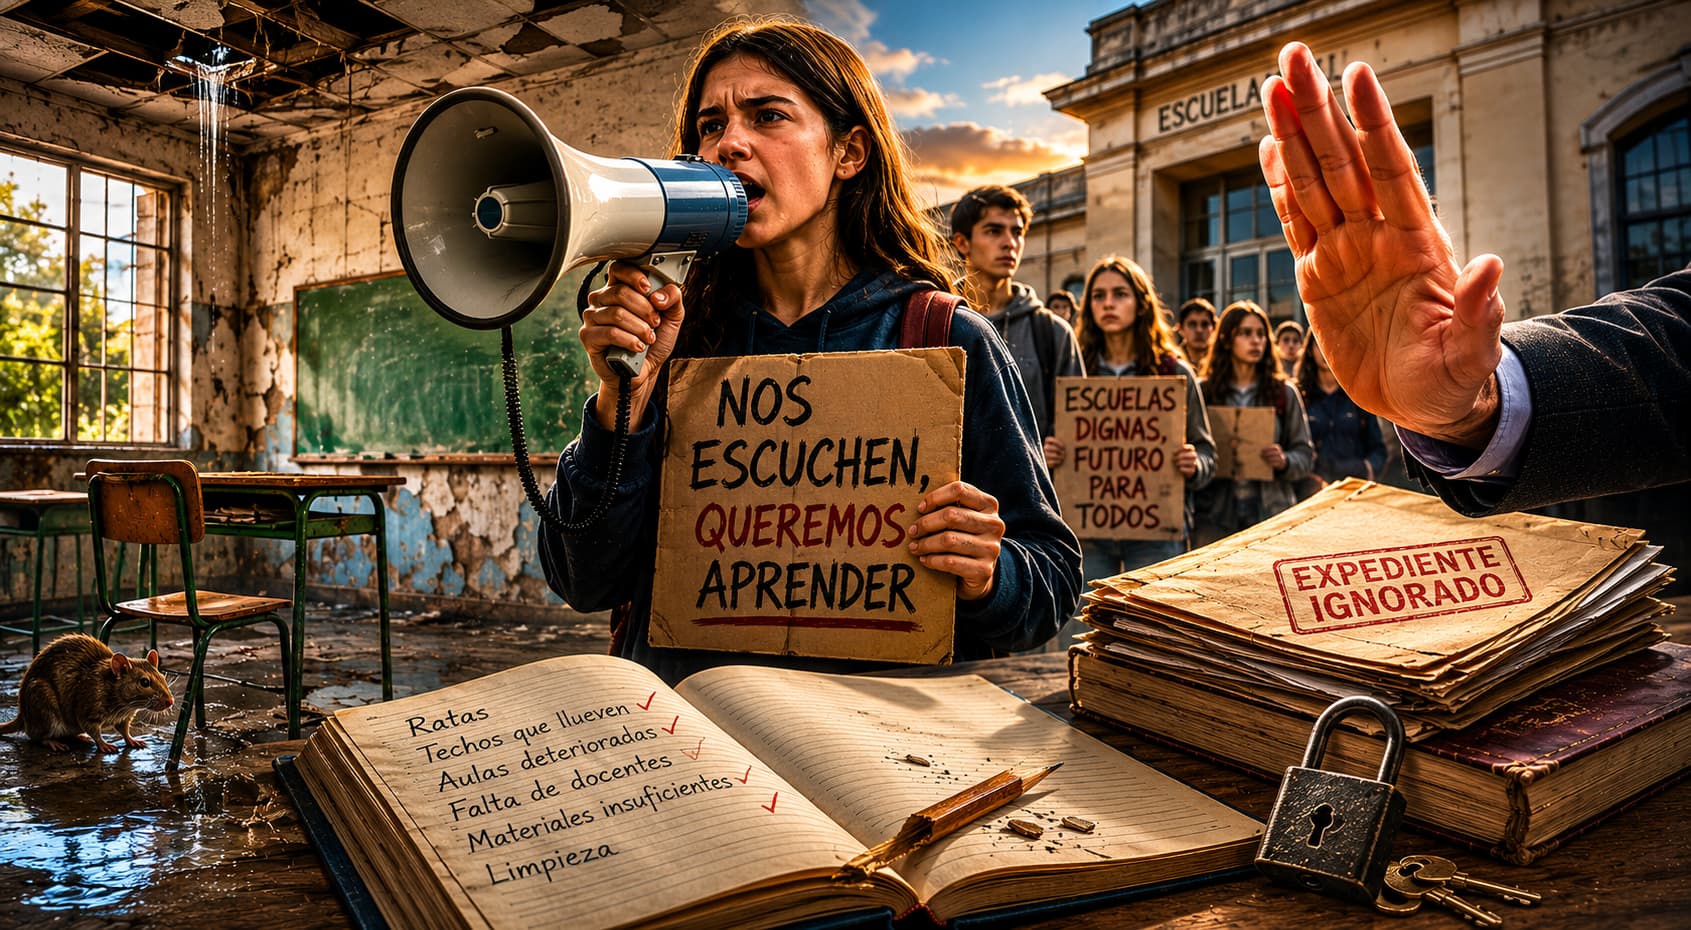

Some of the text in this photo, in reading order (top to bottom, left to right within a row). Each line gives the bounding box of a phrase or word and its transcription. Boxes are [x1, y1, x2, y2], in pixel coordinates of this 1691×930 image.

[1158, 77, 1262, 133] ESCUELA
[716, 374, 813, 428] NOS
[1065, 387, 1176, 411] ESCUELAS
[1075, 417, 1167, 444] DIGNAS,
[690, 428, 930, 493] ESCUCHEN,
[1074, 446, 1164, 471] FUTURO
[1090, 476, 1147, 499] PARA
[695, 502, 906, 553] QUEREMOS
[1075, 504, 1160, 529] TODOS
[696, 559, 917, 614] APRENDER
[1291, 545, 1501, 591] EXPEDIENTE
[1309, 572, 1506, 623] IGNORADO
[405, 705, 490, 737] Ratas
[416, 703, 631, 764] Techos que llueven
[438, 724, 658, 793] Aulas deterioradas
[449, 752, 673, 822] Falta de docentes
[467, 774, 734, 855] Materiales insuficientes
[486, 842, 618, 885] Limpieza
